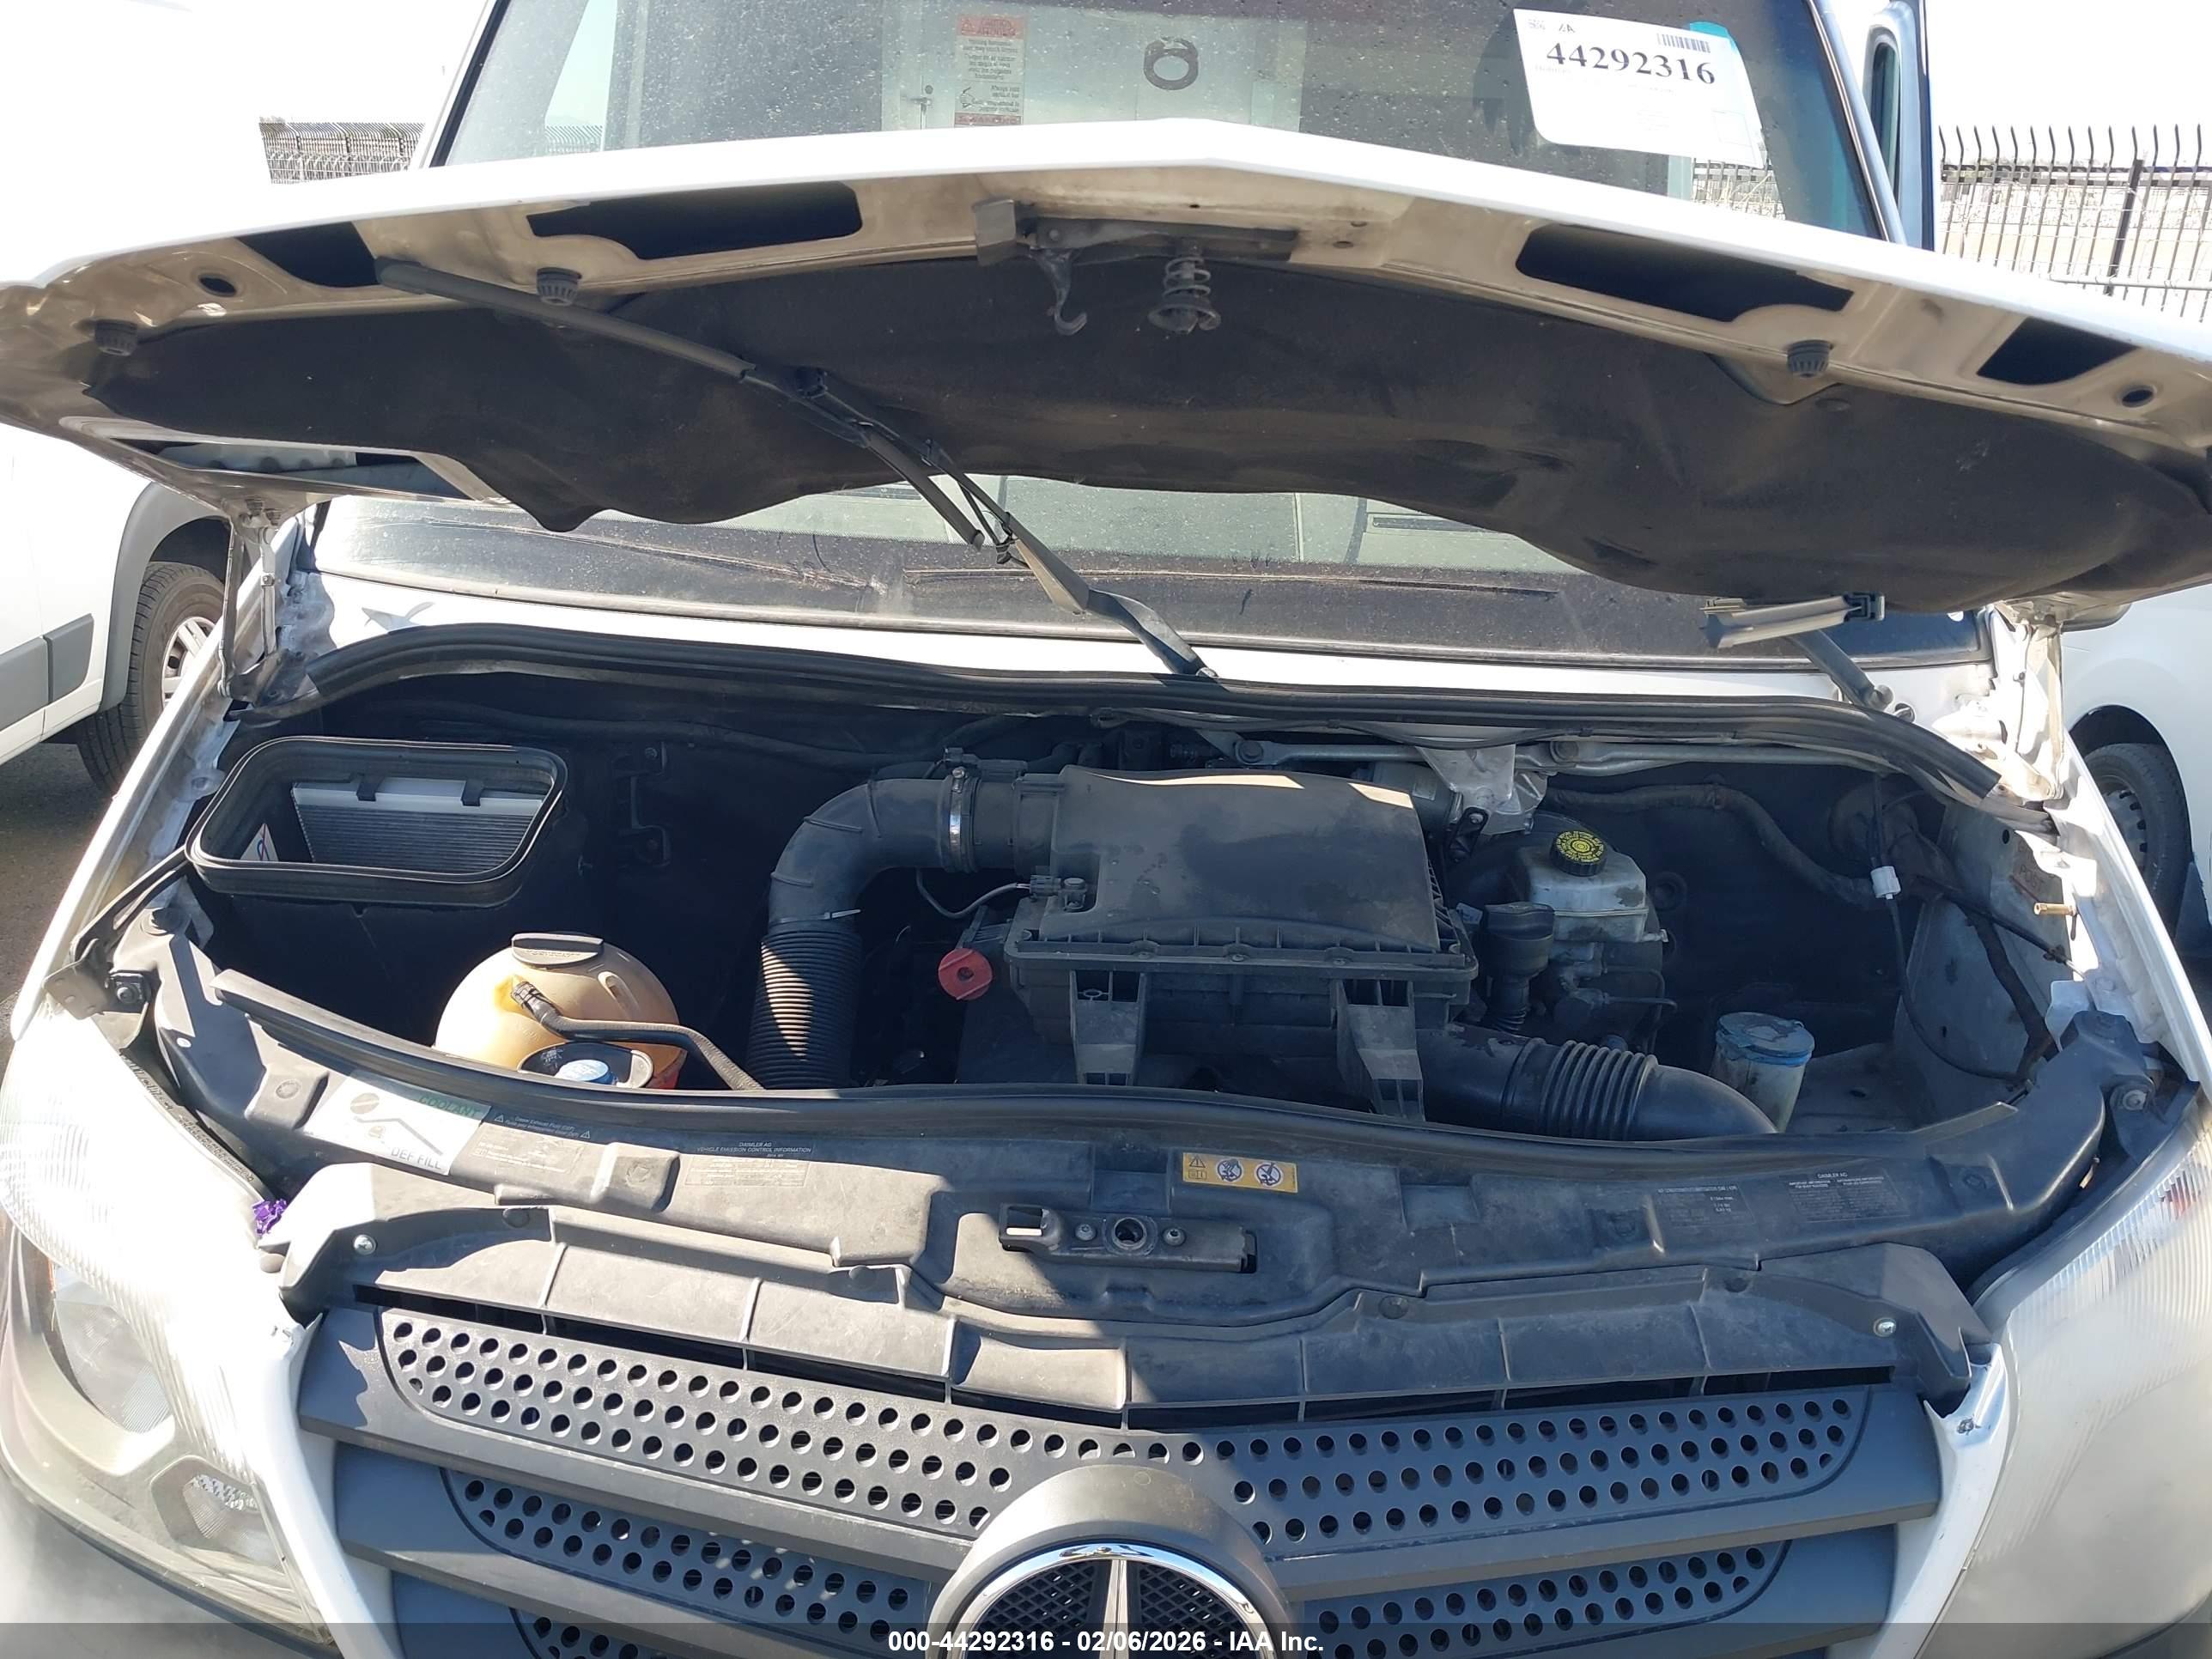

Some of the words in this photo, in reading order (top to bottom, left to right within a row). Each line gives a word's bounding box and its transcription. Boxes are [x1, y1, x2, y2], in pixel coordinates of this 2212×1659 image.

[1547, 43, 1716, 84] 44292316
[419, 1095, 479, 1118] COOLANT
[391, 1146, 414, 1161] DEF
[416, 1155, 441, 1170] FILL
